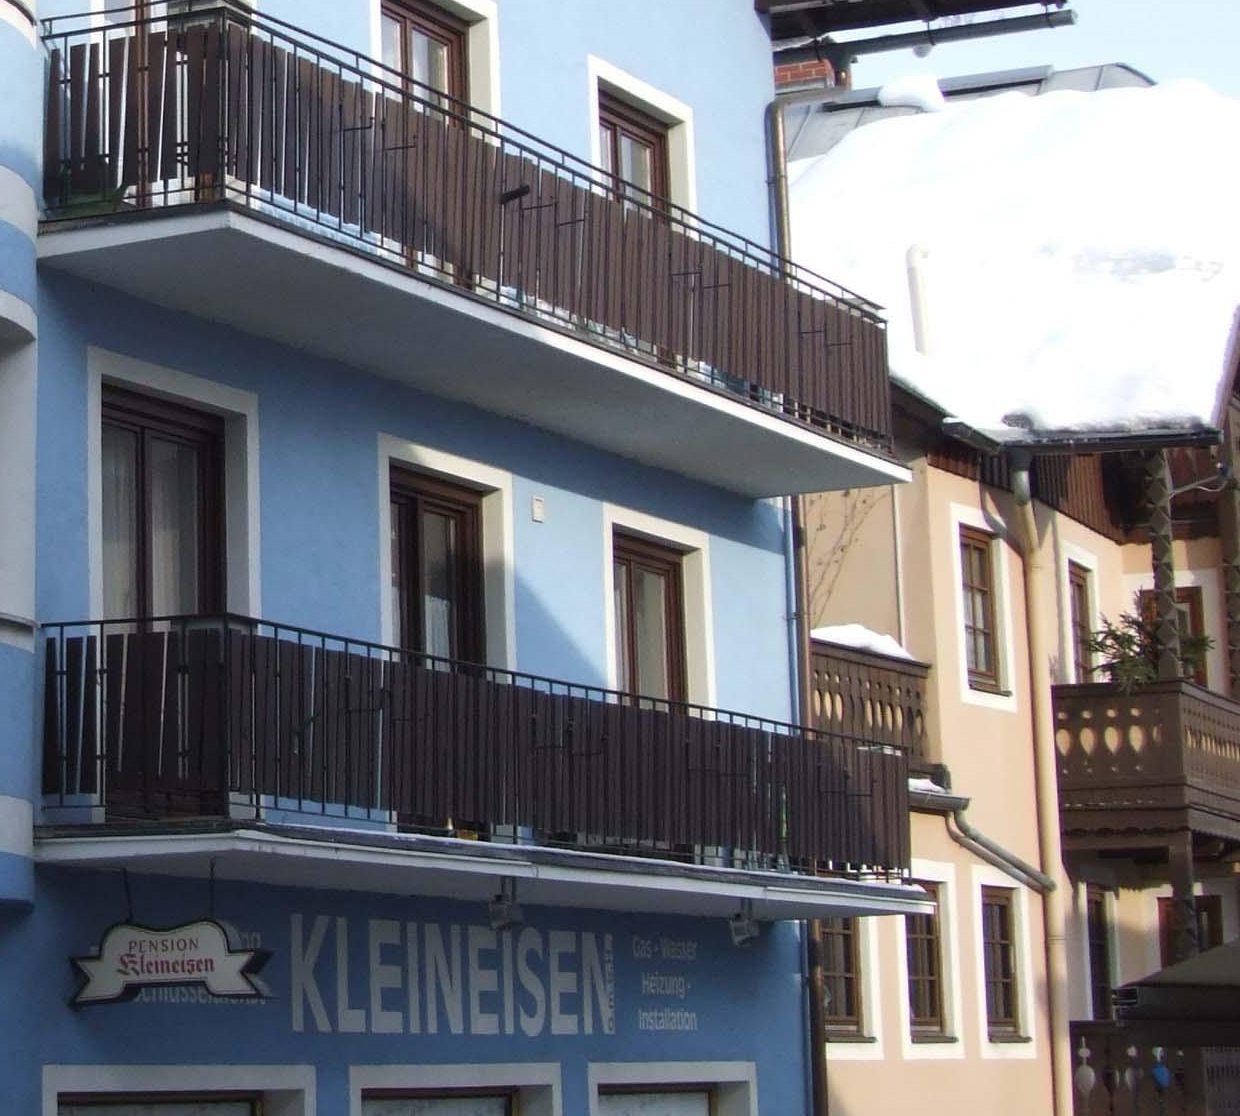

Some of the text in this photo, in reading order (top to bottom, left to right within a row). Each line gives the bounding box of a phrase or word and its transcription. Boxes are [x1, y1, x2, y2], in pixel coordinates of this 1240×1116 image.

[128, 938, 199, 953] PENSION
[116, 953, 216, 976] Kleineisen
[290, 914, 615, 1036] KLEINEISEN
[641, 971, 686, 999] Heizung
[638, 1006, 698, 1031] Installation
